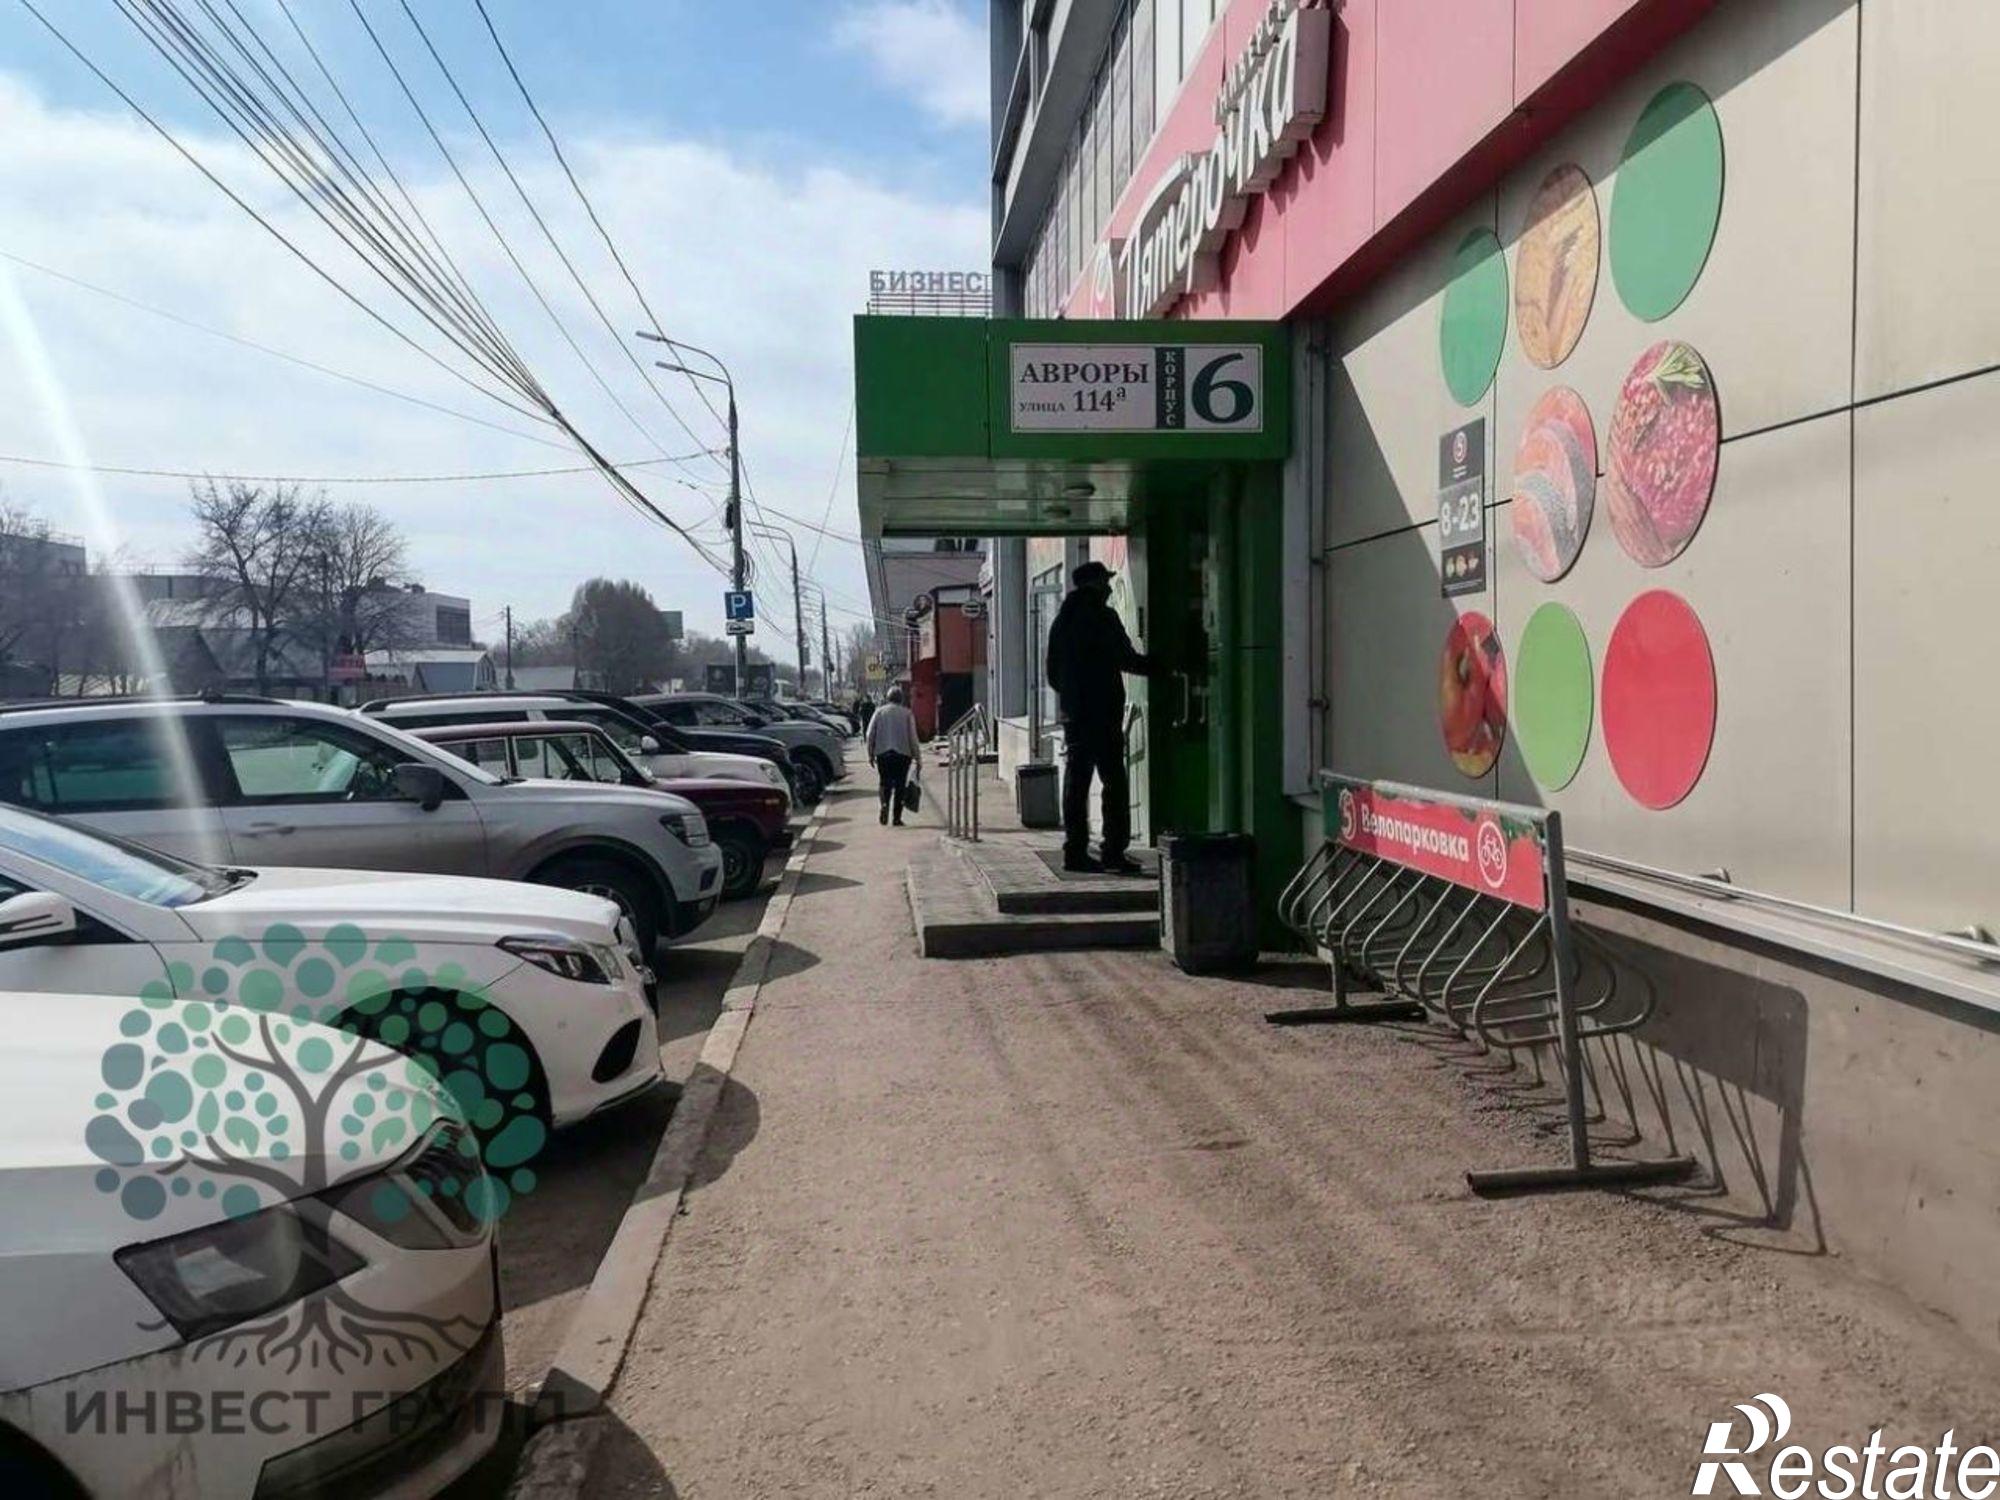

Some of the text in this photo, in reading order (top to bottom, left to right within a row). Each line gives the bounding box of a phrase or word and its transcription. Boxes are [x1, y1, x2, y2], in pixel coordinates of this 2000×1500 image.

[869, 270, 982, 293] БИЗНЕС
[1019, 362, 1149, 384] АВРОРЫ
[1164, 351, 1177, 426] КОРПУС
[1191, 352, 1254, 424] 6
[1441, 492, 1480, 536] 8-23
[1360, 802, 1470, 863] Велопарковка
